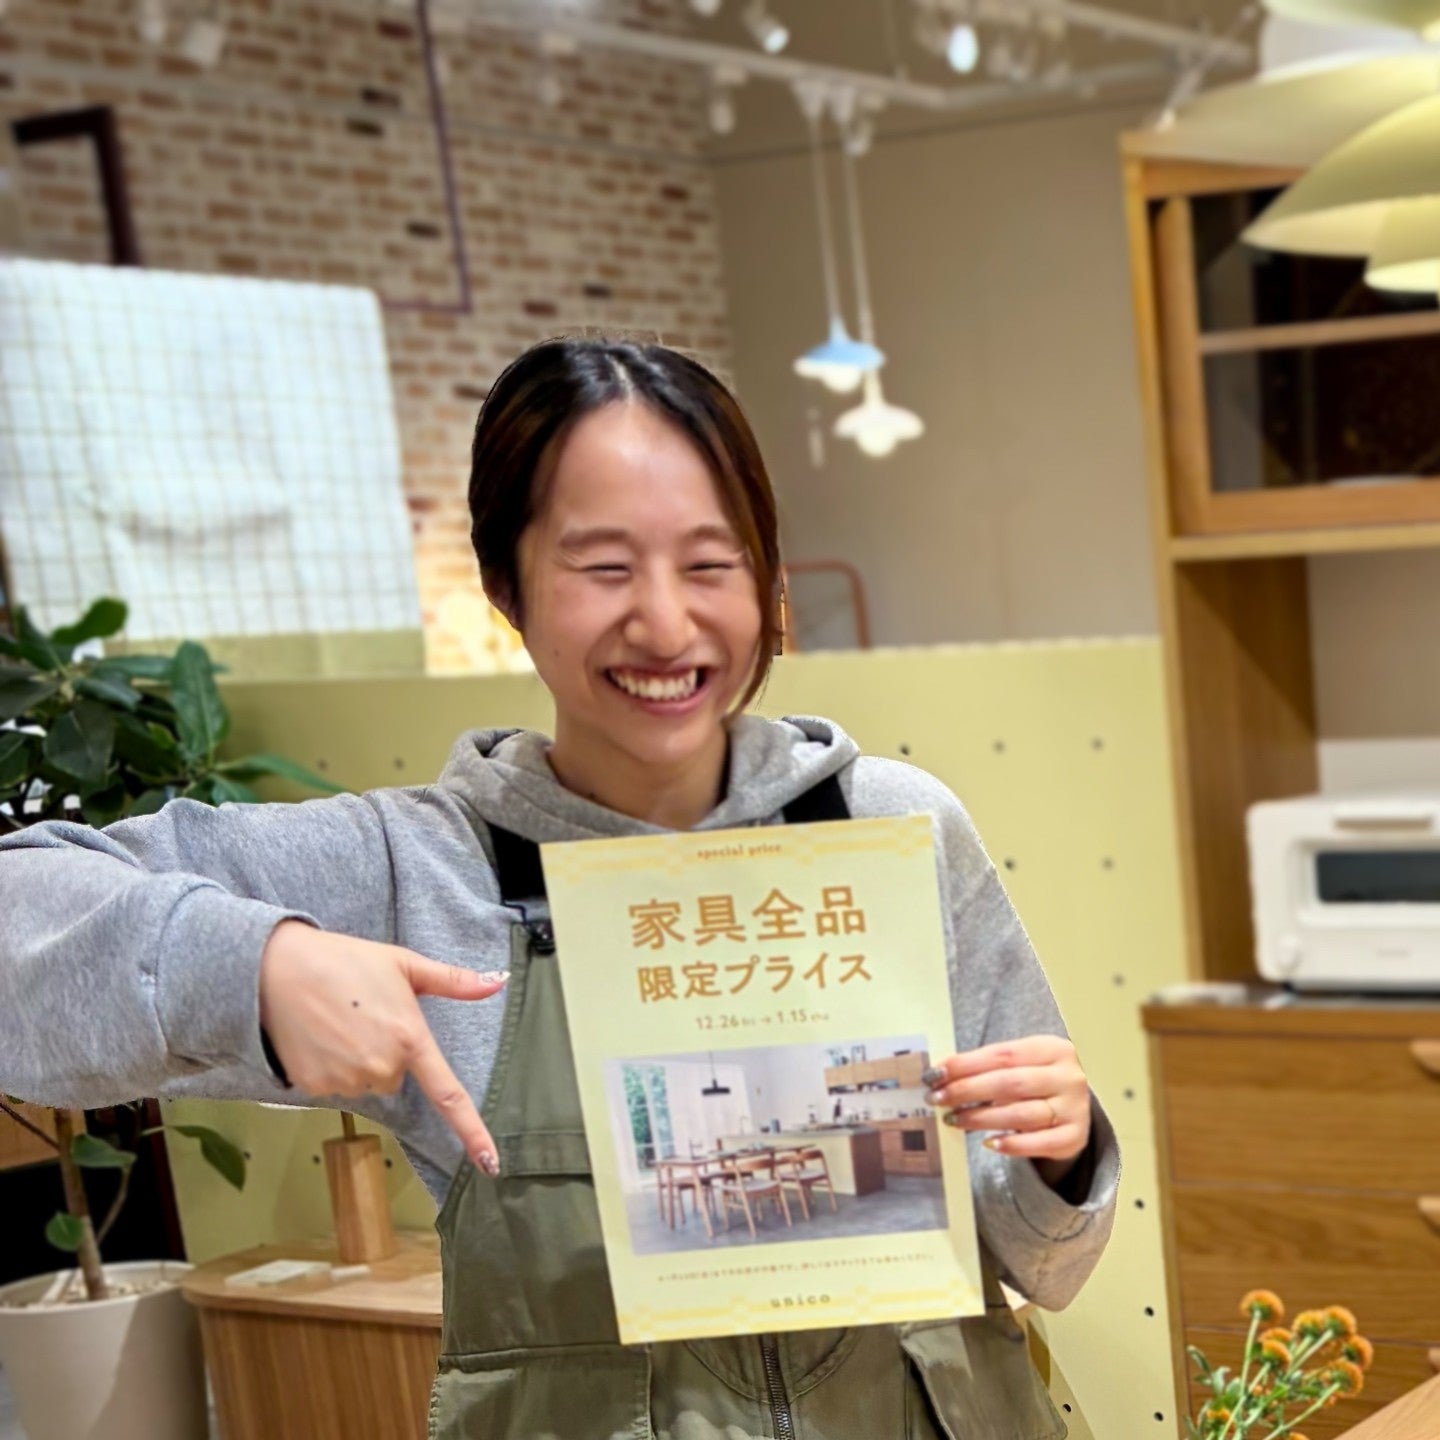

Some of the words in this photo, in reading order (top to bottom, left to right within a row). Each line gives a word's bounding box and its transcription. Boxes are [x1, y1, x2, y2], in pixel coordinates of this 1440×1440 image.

[696, 843, 743, 861] special
[748, 843, 783, 857] price
[628, 885, 866, 950] 家具全品
[637, 952, 872, 1003] 限定プライス
[770, 1293, 831, 1309] unico
